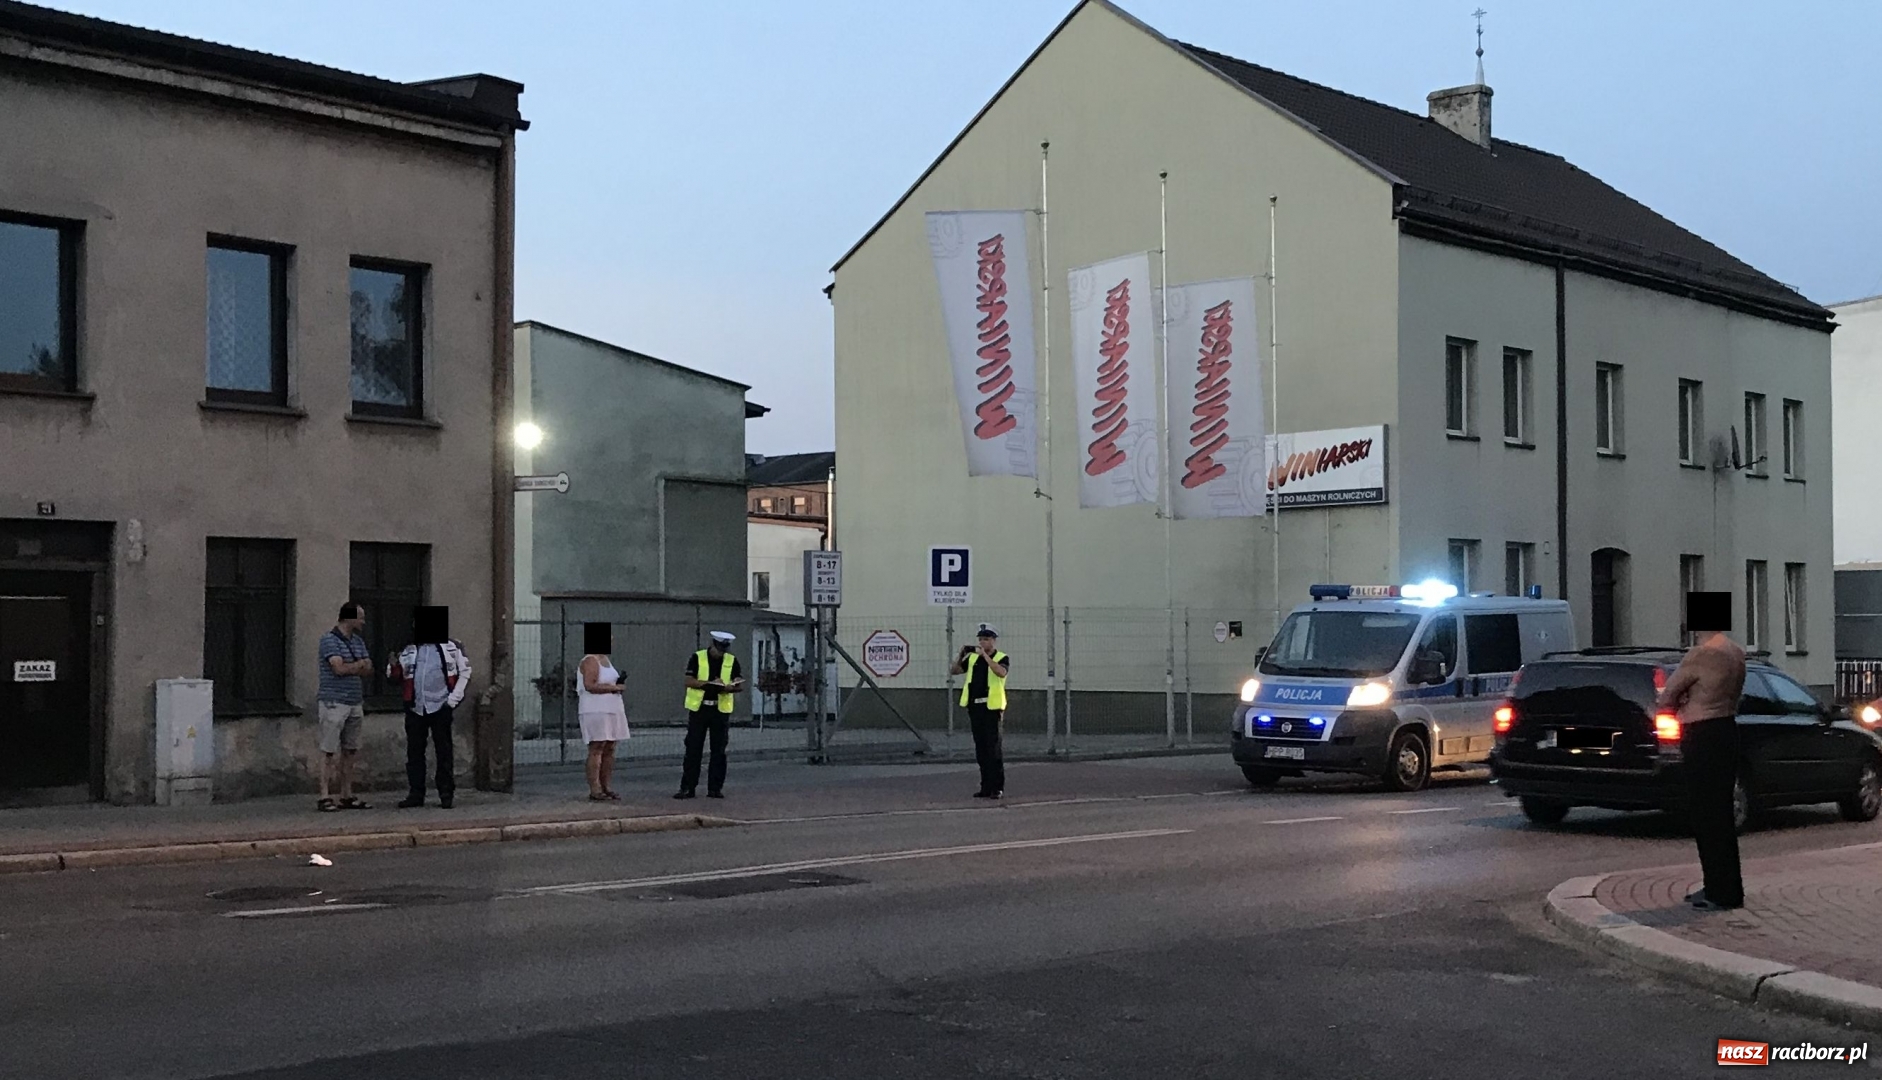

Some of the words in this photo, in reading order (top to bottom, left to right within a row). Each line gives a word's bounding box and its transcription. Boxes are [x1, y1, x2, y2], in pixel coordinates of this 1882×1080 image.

[1267, 438, 1373, 491] WINIARSKI
[1296, 493, 1326, 502] MASZYN
[1328, 491, 1376, 500] ROLNICZYCH
[941, 553, 961, 582] P
[1350, 586, 1388, 596] POLICJA
[19, 664, 51, 672] ZAKAZ
[1275, 688, 1322, 700] POLICJA
